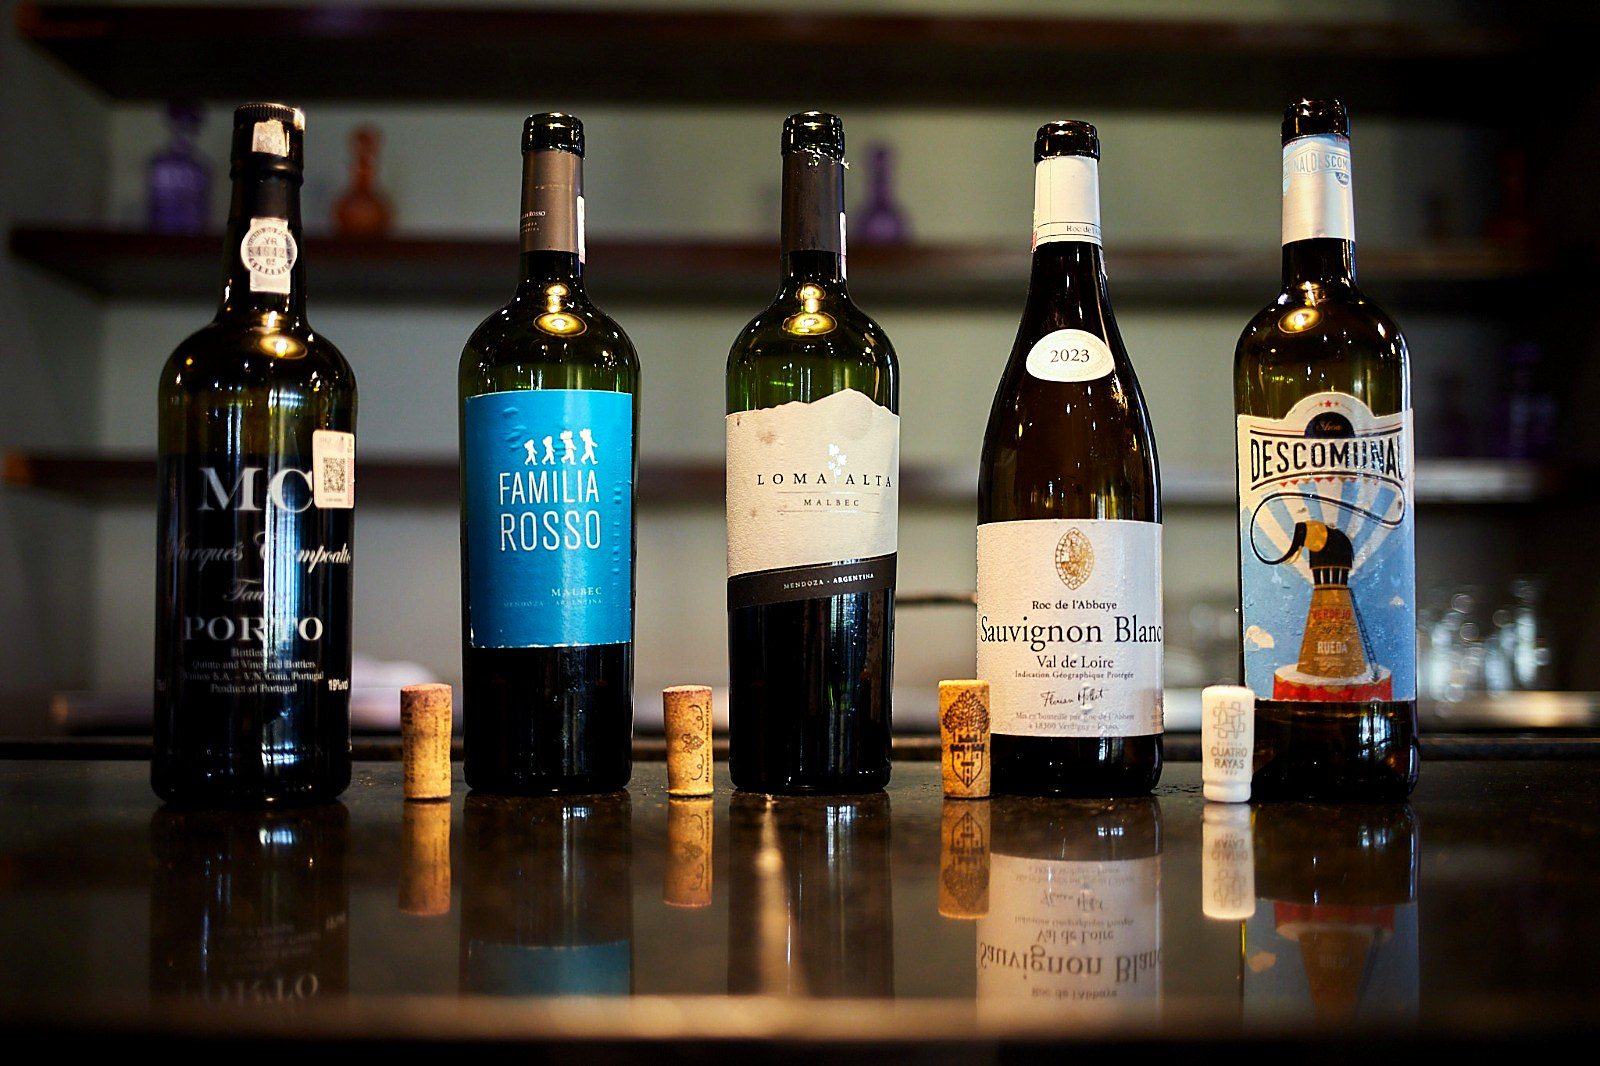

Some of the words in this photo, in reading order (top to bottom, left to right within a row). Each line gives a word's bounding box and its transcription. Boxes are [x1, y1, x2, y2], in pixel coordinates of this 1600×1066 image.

[1050, 348, 1090, 363] 2023
[1250, 434, 1404, 482] DESCOMUNAL
[499, 470, 600, 505] FAMILIA
[757, 474, 827, 486] LOMA
[845, 474, 892, 488] ALTA
[197, 466, 313, 514] MC
[500, 510, 601, 551] ROSSO
[783, 579, 824, 590] MENDOZA
[832, 573, 875, 584] ARGENTINA
[552, 586, 602, 596] MALBEC
[1032, 600, 1051, 610] Roc
[1055, 600, 1068, 610] de
[1072, 600, 1118, 612] l'Abbaye
[980, 616, 1102, 652] Sauvignon
[1114, 614, 1162, 644] Blanc
[1318, 641, 1348, 654] RUEDA
[1036, 656, 1057, 668] Val
[1062, 656, 1078, 668] de
[1081, 656, 1114, 668] Loire
[1015, 670, 1050, 678] Indication
[210, 684, 246, 693] Product
[260, 684, 298, 694] Portugal
[1211, 746, 1248, 758] CUATRO
[1214, 759, 1244, 769] RAYAS
